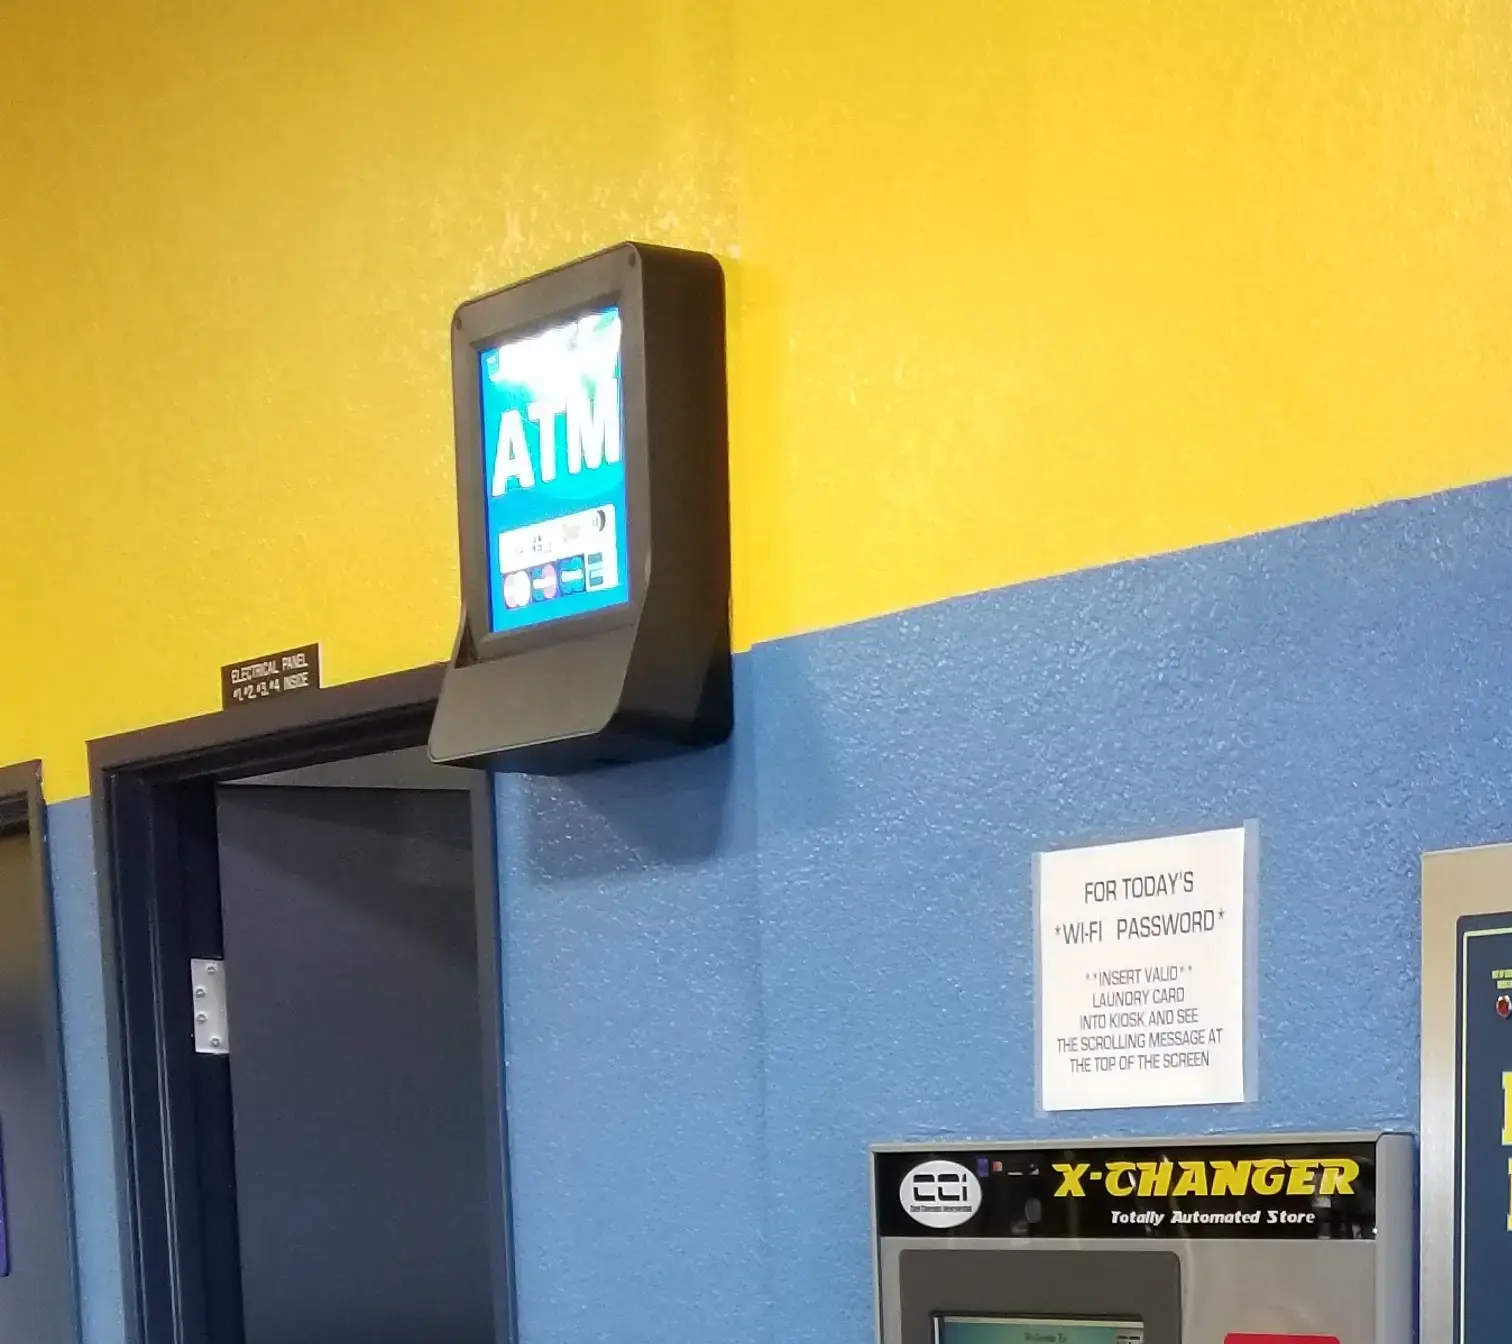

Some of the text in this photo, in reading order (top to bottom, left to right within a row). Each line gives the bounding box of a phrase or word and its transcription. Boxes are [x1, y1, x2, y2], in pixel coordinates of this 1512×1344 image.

[490, 378, 621, 497] ATM
[1085, 871, 1194, 903] FOR TODAY'S
[1093, 987, 1185, 1008] LAUNDRY CARD
[1080, 1008, 1199, 1030] INTO KIOSK AND SEE
[1057, 1028, 1222, 1053] THE SCROLLING MESSAGE AT
[1070, 1050, 1209, 1073] THE TOP OF THE SCREEN
[1051, 1156, 1360, 1197] X-CHANGER
[1110, 1208, 1316, 1227] Totally Automated Store
